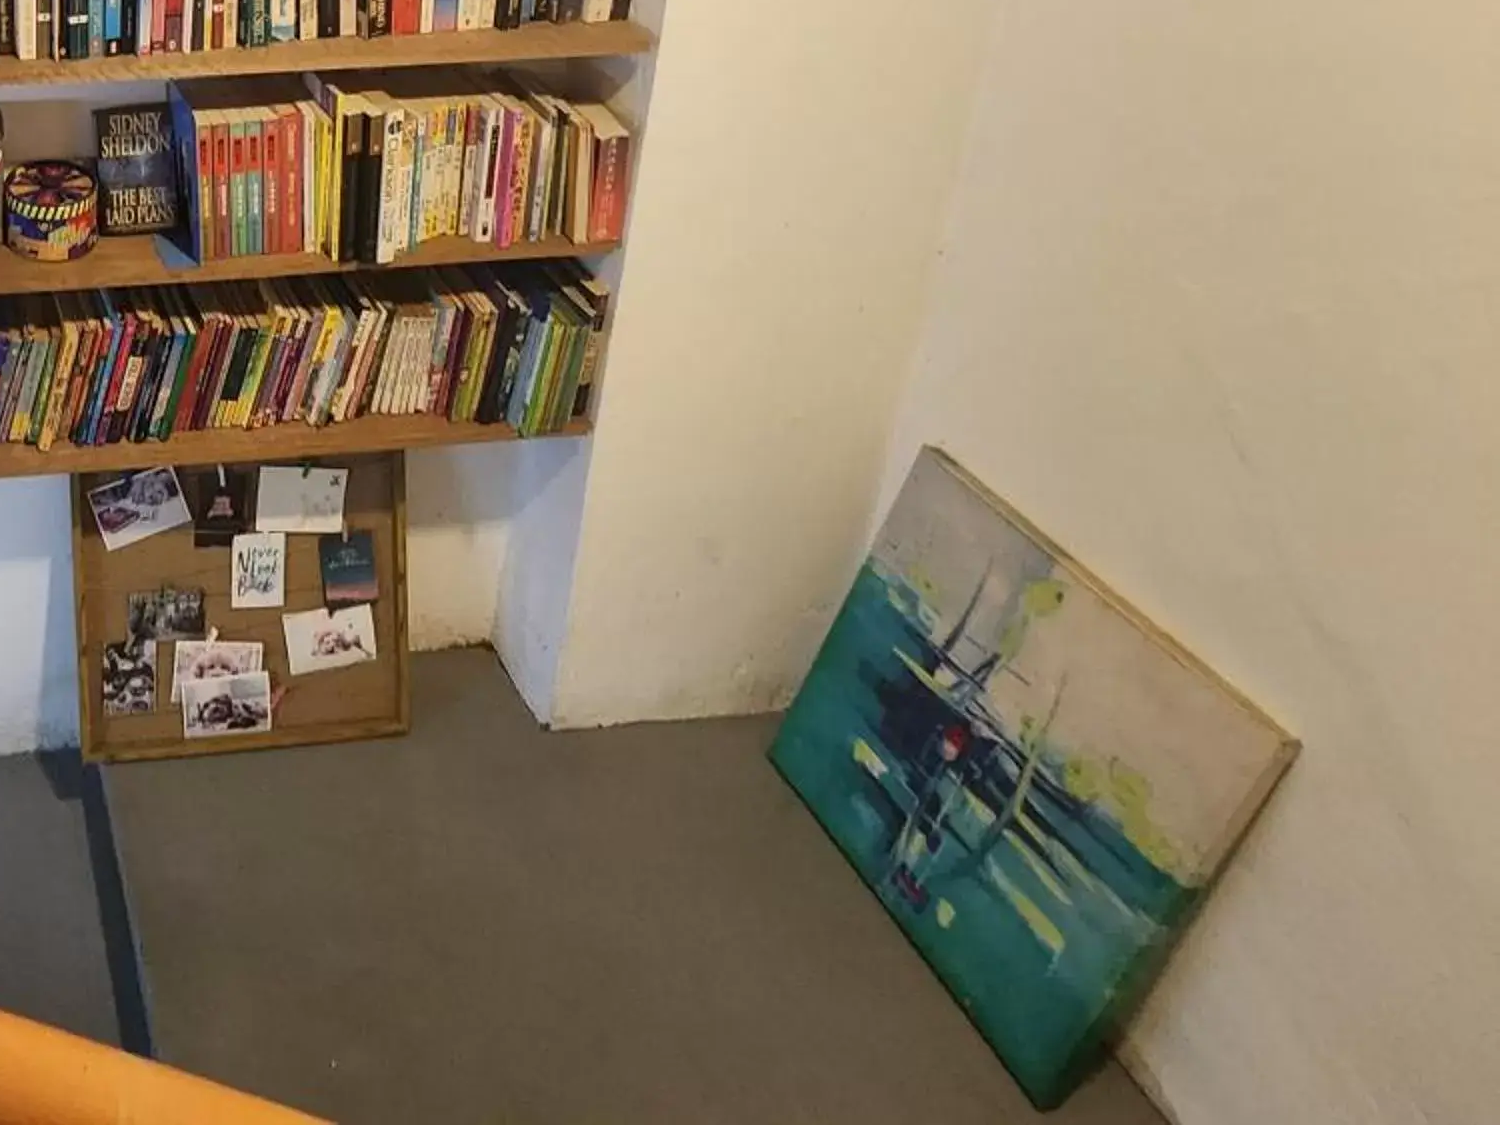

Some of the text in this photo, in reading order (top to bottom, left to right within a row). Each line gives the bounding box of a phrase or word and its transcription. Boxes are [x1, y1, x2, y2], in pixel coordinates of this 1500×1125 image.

[109, 112, 162, 135] SIDNEY
[101, 134, 171, 159] SHELDON
[109, 186, 167, 208] THE BEST
[105, 203, 175, 226] LAID PLANS
